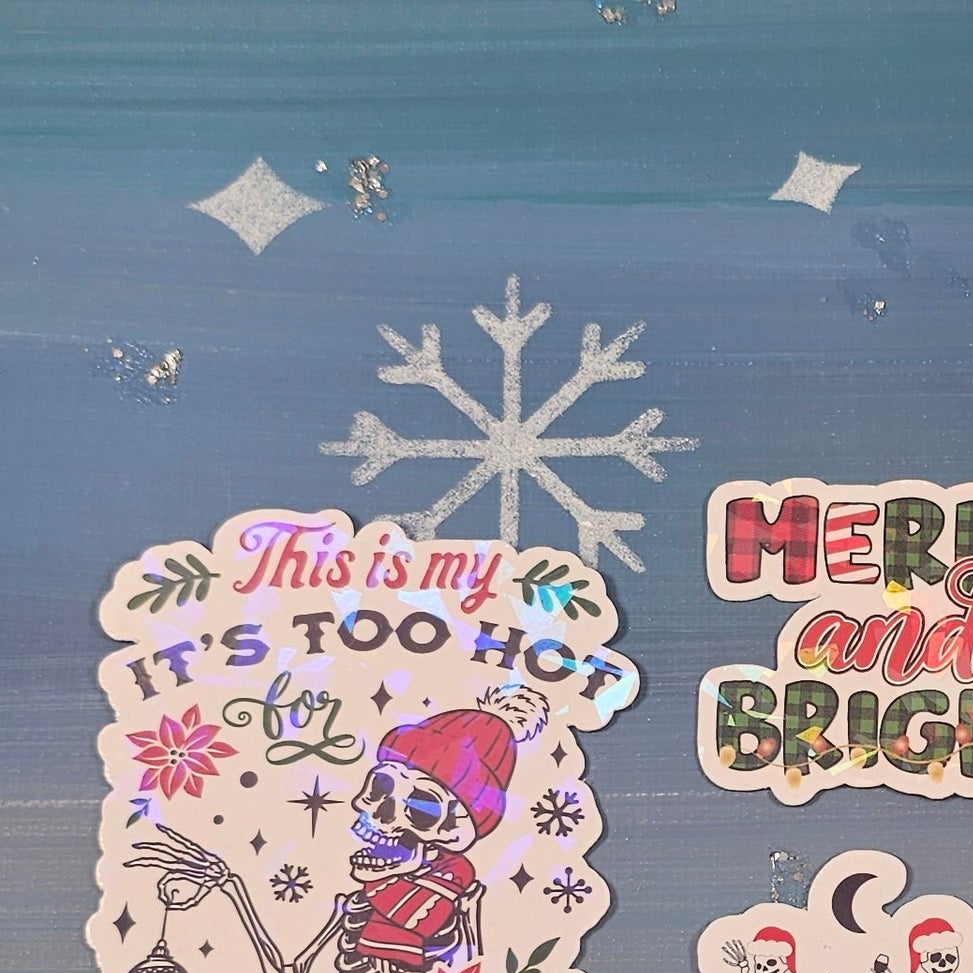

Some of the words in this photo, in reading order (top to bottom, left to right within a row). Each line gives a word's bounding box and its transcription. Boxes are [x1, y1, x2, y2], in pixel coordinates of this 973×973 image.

[233, 521, 351, 594] This
[366, 533, 412, 589] is
[420, 552, 504, 613] my
[125, 624, 270, 700] IT'S
[292, 610, 452, 654] TOO
[470, 620, 625, 701] HOT
[223, 670, 365, 766] for
